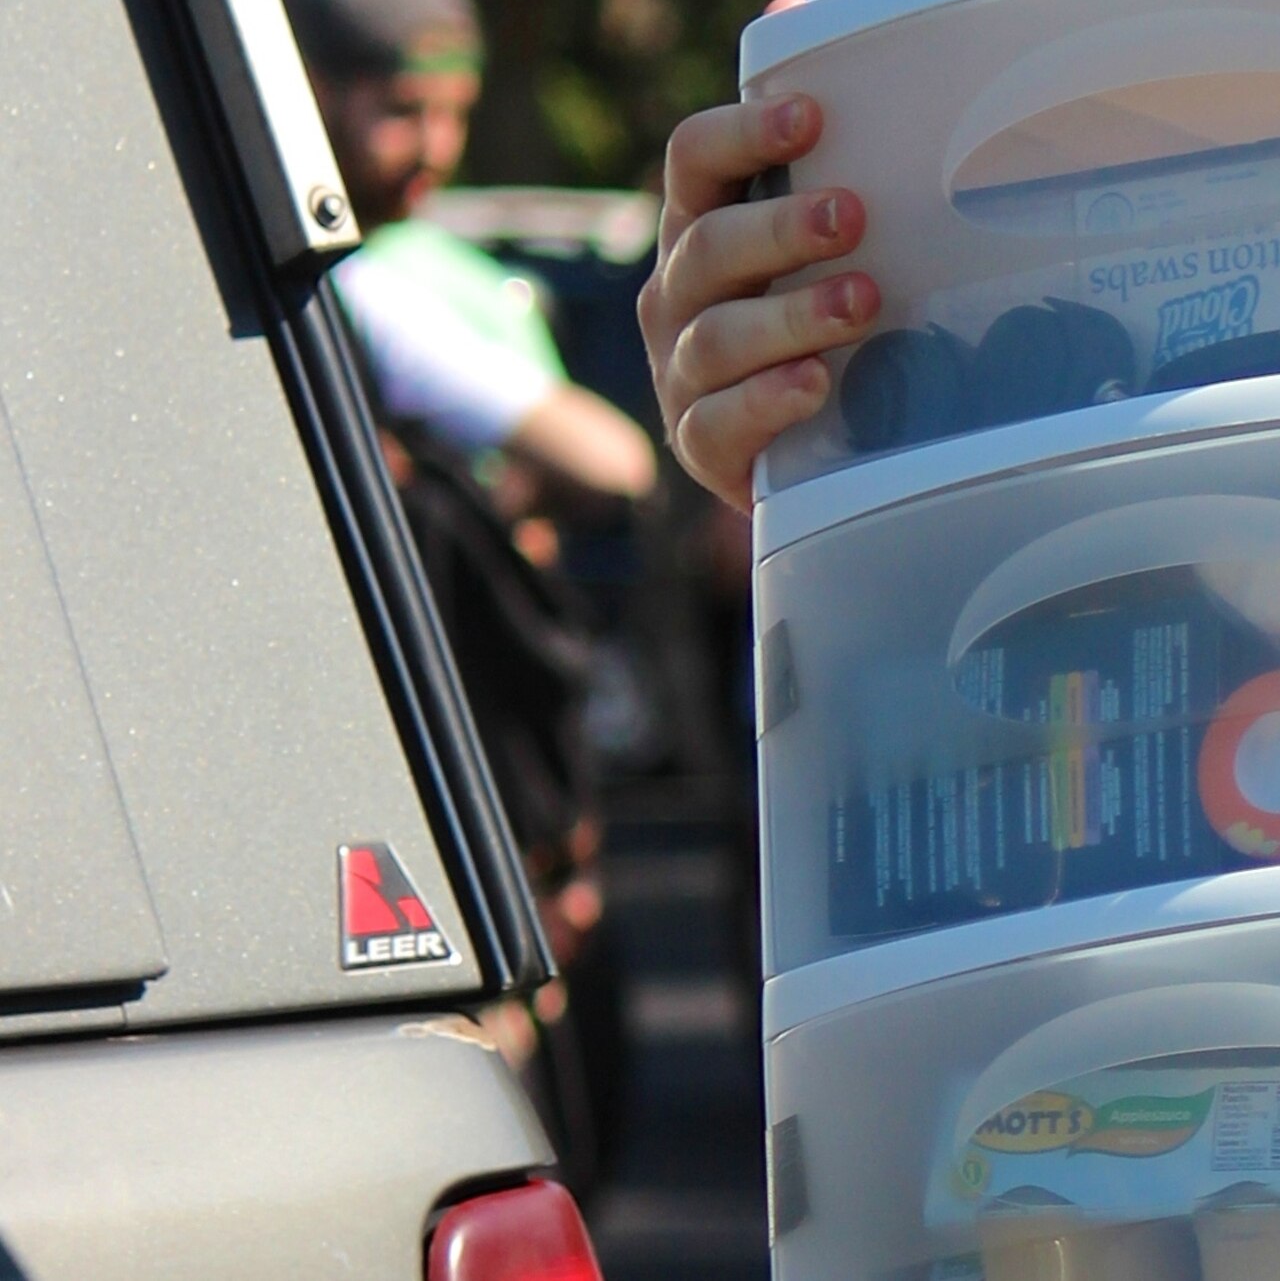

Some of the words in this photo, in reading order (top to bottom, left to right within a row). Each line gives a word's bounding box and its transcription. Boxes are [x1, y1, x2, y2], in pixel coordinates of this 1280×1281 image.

[1089, 251, 1199, 303] swabs
[1158, 279, 1257, 350] Cloud
[346, 931, 445, 964] LEER
[1111, 1109, 1192, 1125] Applesauce
